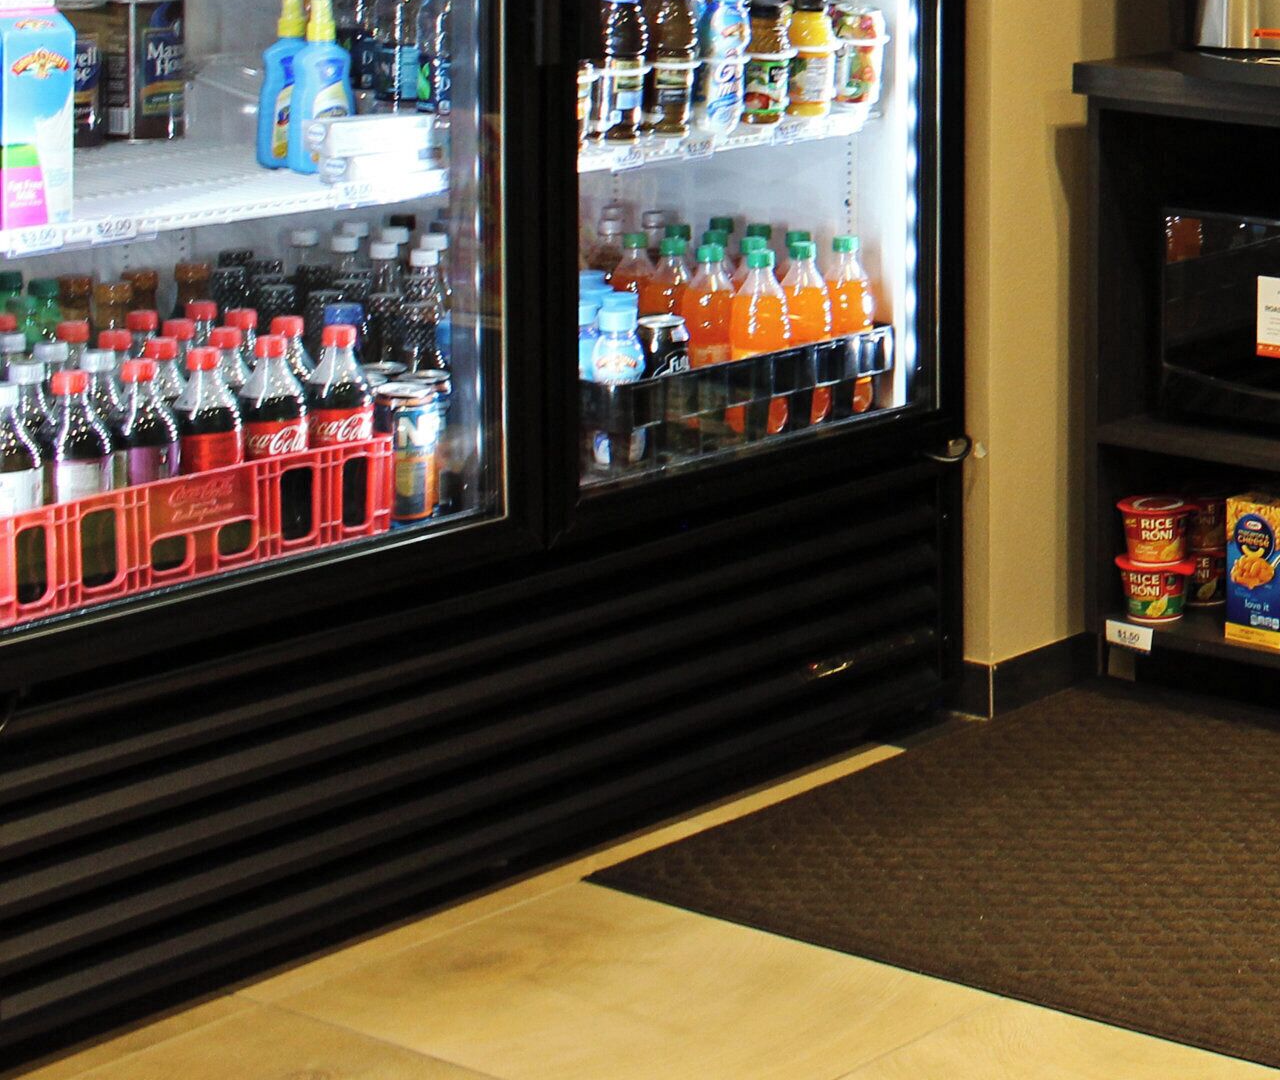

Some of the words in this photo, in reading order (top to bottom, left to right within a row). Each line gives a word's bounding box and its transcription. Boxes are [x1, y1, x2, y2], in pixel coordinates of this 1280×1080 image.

[1141, 518, 1173, 531] RICE
[1142, 528, 1173, 542] RONI
[1129, 573, 1161, 587] RICE
[1130, 585, 1161, 597] RONI
